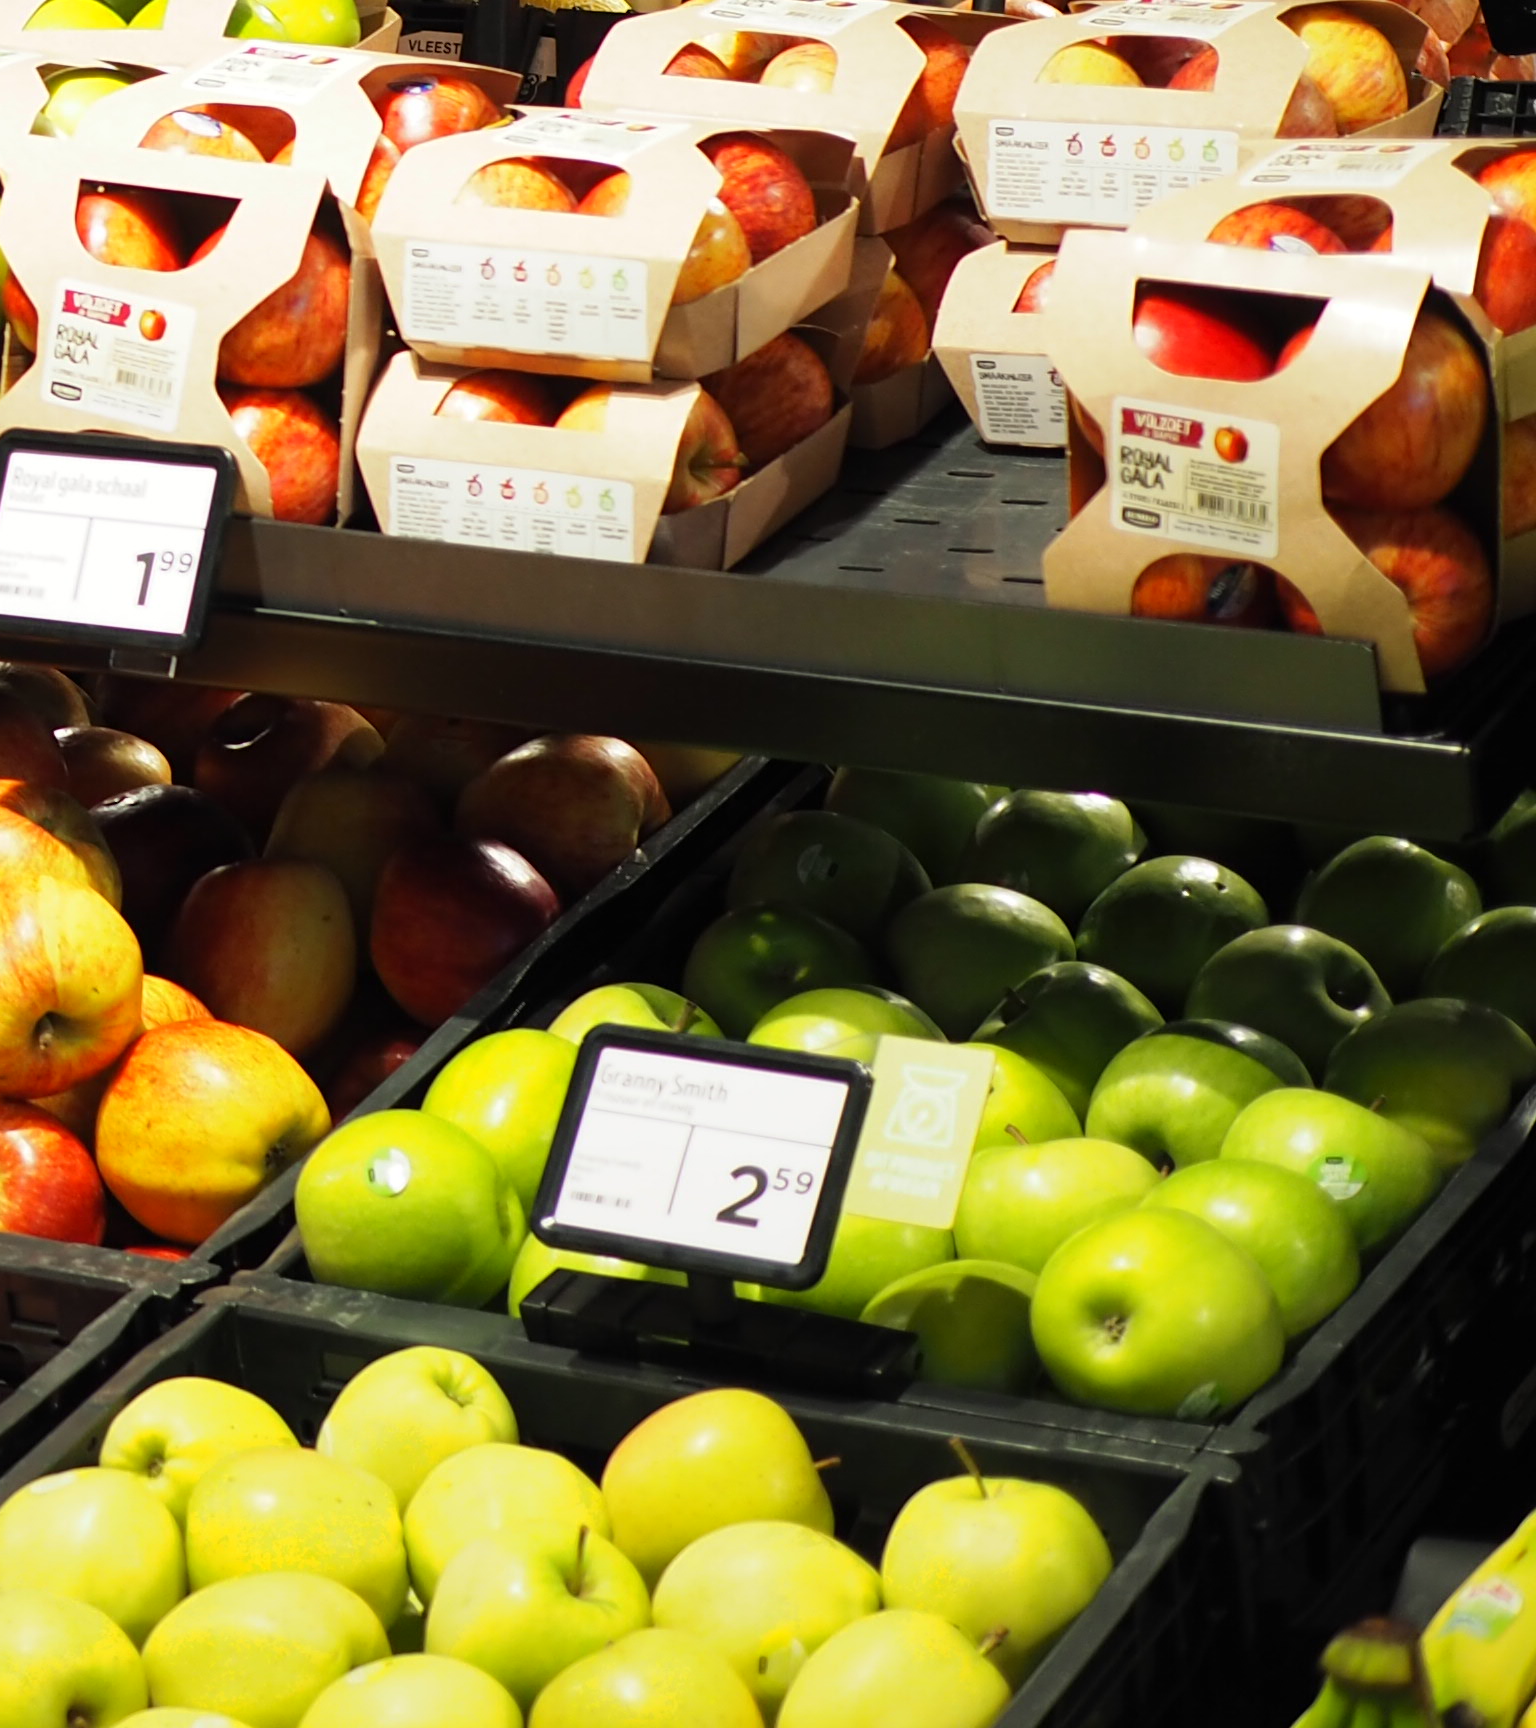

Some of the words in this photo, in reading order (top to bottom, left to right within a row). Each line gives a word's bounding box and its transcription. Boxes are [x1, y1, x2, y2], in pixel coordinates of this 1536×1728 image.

[1120, 445, 1173, 473] ROYAL
[1120, 467, 1164, 490] GALA
[598, 1064, 666, 1102] Granny
[671, 1072, 729, 1103] Smith
